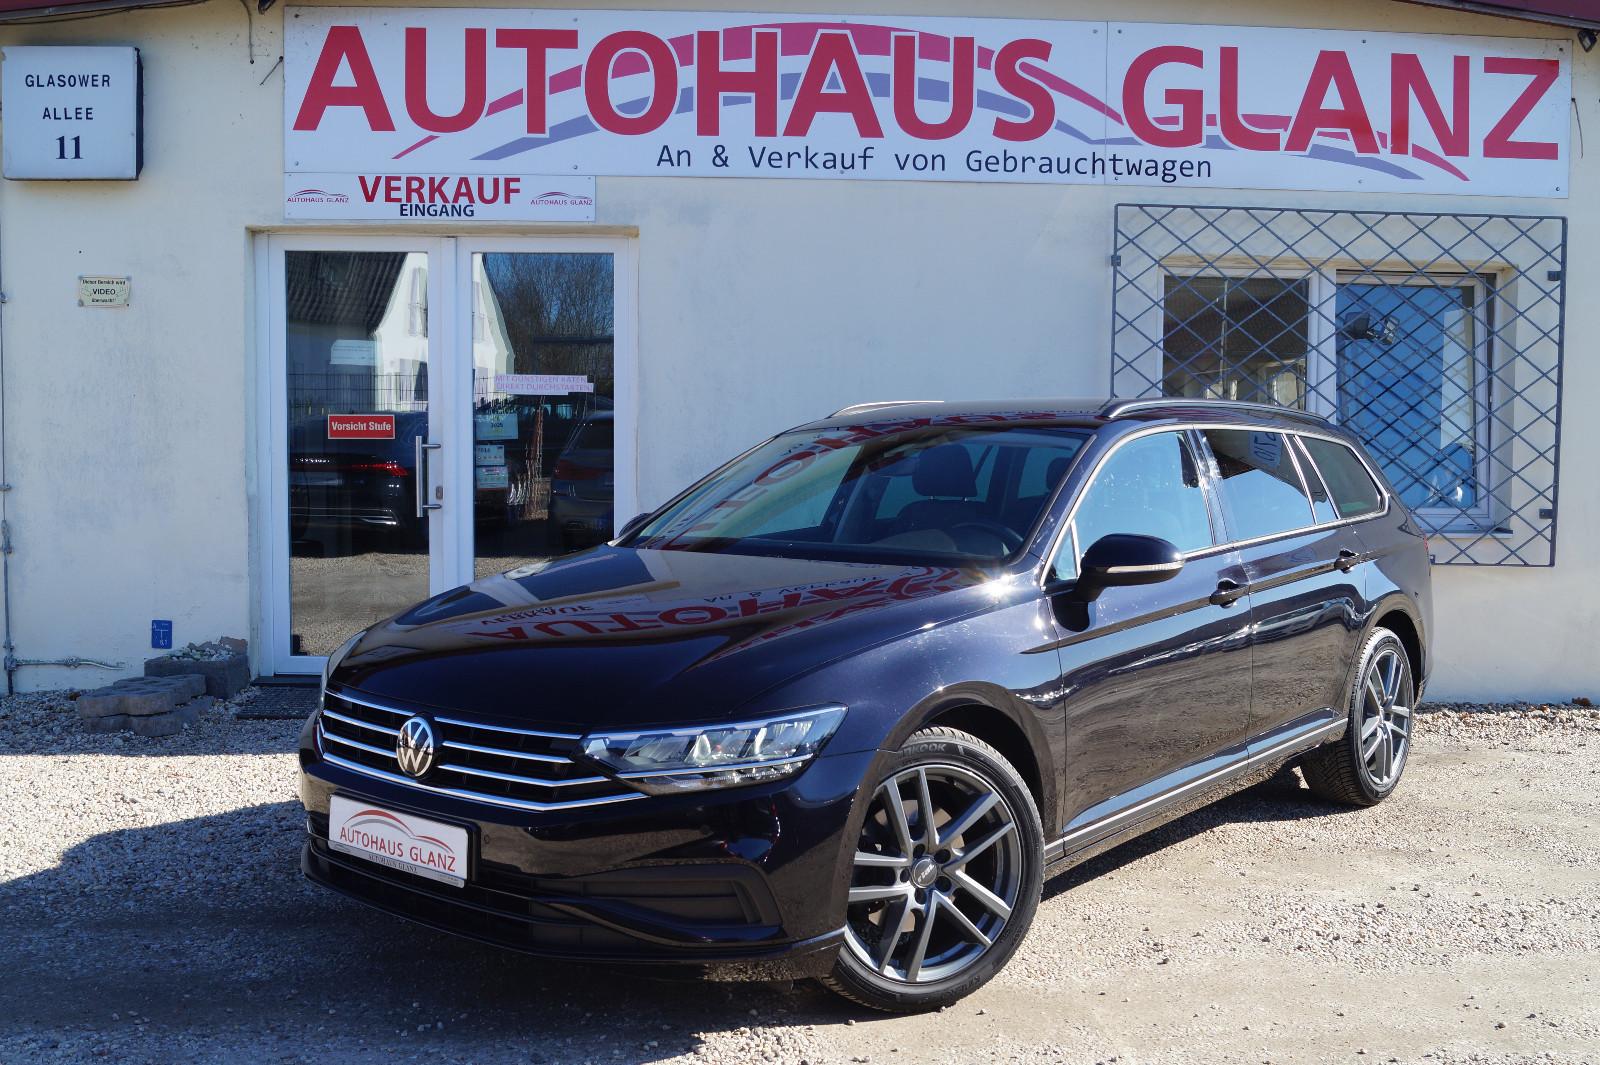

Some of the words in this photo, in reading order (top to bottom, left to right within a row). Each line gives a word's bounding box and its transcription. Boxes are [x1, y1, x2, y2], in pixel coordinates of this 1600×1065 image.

[24, 73, 111, 88] GLASOWER
[293, 25, 1056, 142] AUTOHAUS
[1122, 45, 1560, 160] GLANZ
[42, 106, 94, 120] ALLEE
[55, 135, 84, 160] 11
[656, 145, 692, 168] An
[711, 146, 730, 169] &
[748, 145, 875, 171] Verkauf
[895, 152, 946, 172] von
[966, 149, 1212, 183] Gebrauchtwagen
[358, 175, 521, 205] VERKAUF
[400, 203, 475, 217] EINGANG
[331, 421, 367, 431] Vorsicht
[368, 421, 392, 431] Stufe
[397, 717, 434, 777] VW
[340, 826, 404, 858] AUTOHAUS
[409, 846, 456, 873] GLANZ
